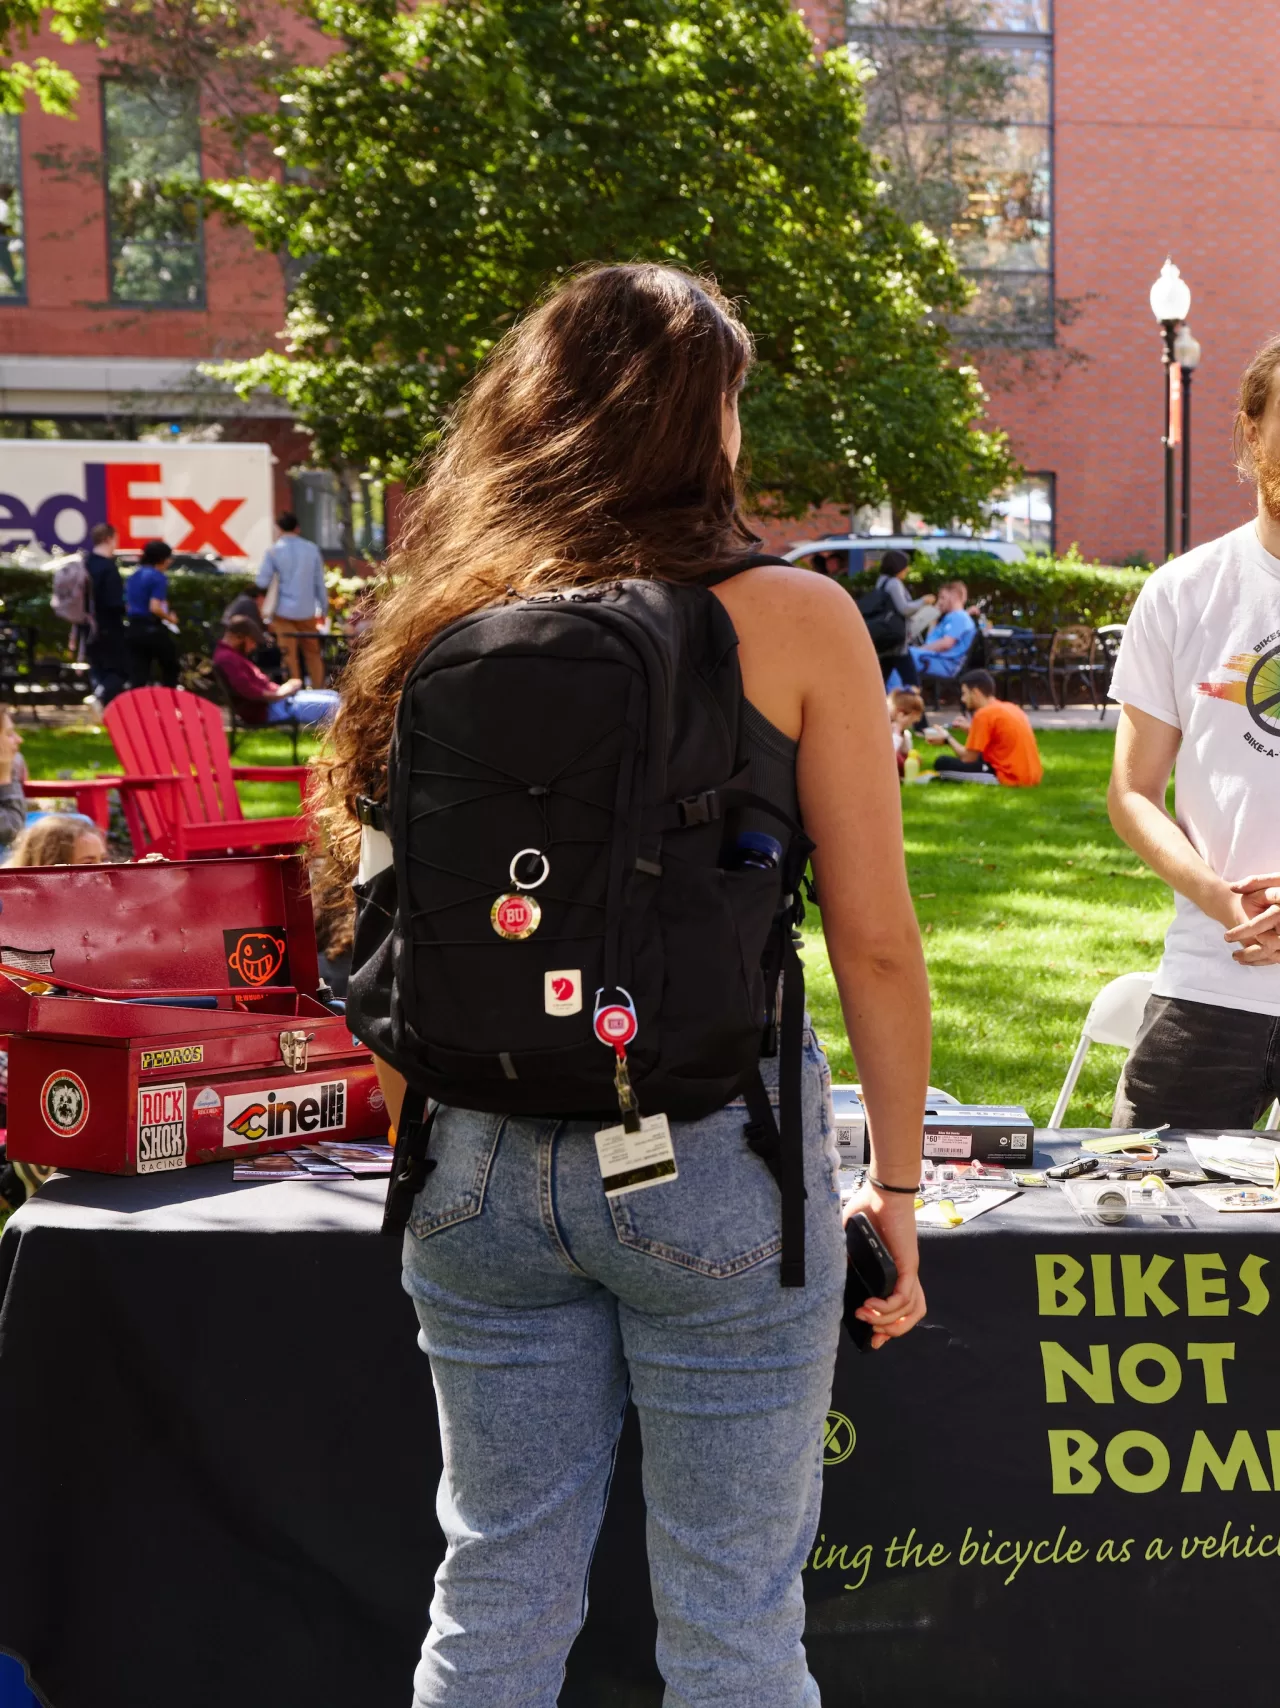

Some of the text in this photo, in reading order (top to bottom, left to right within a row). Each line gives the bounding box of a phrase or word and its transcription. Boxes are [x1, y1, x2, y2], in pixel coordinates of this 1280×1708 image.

[506, 908, 524, 923] BU
[142, 1046, 202, 1069] PEDRO'S
[142, 1090, 183, 1126] ROCK
[227, 1083, 344, 1141] cinelli
[141, 1124, 183, 1160] SHOX
[141, 1158, 183, 1172] RACING
[1035, 1253, 1270, 1317] BIKES
[1040, 1341, 1236, 1404] NOT
[801, 1534, 873, 1589] ing
[884, 1528, 952, 1568] the
[958, 1526, 1090, 1586] bicycle
[1096, 1536, 1136, 1563] as
[1145, 1535, 1174, 1561] a
